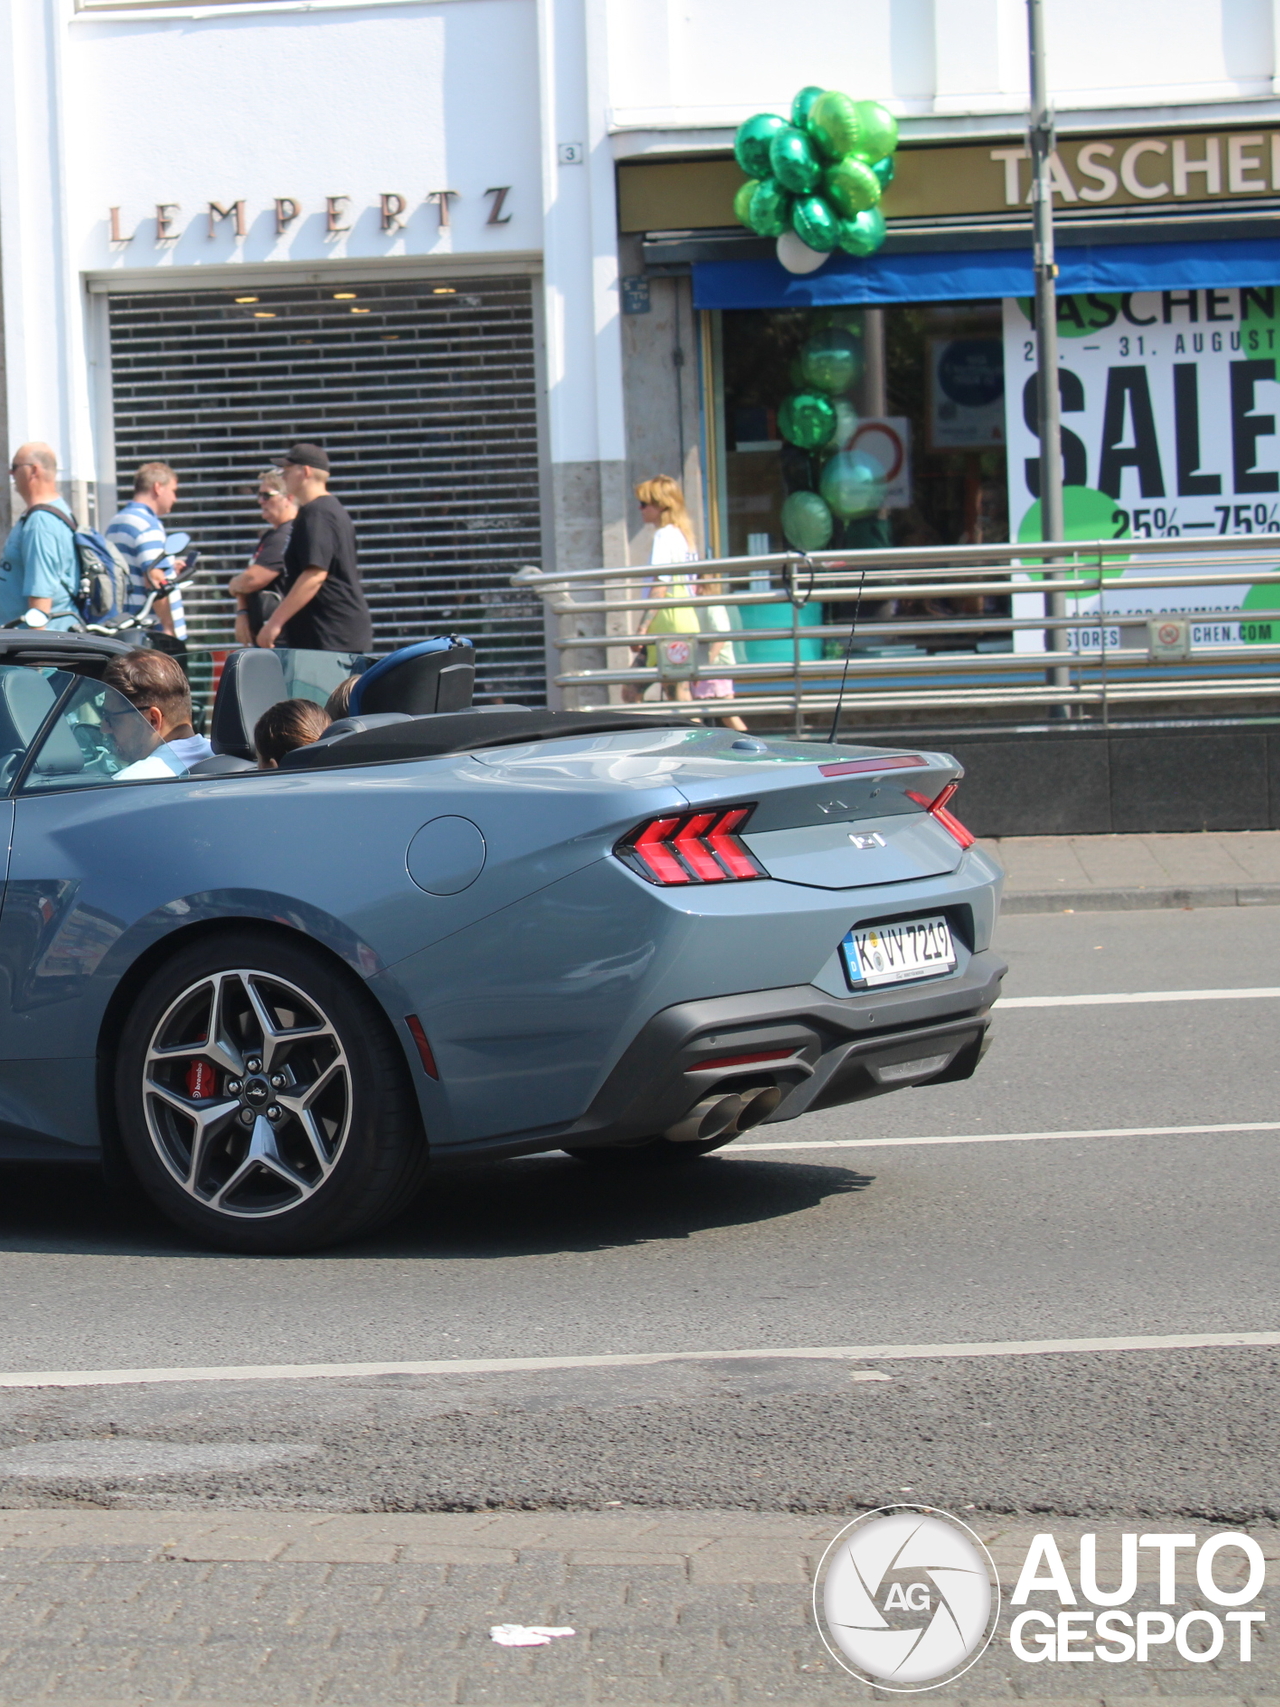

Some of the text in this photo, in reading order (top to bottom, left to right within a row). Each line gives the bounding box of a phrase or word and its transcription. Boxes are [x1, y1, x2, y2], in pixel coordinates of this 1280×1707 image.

[566, 147, 575, 161] 3
[990, 133, 1280, 205] TASCHE
[110, 186, 513, 243] LEMPERTZ
[1030, 287, 1275, 331] ASCHEN
[1024, 341, 1064, 361] 2.
[1120, 336, 1157, 356] 31.
[1175, 329, 1276, 354] AUGUST
[1023, 358, 1279, 500] SALE
[1193, 623, 1272, 643] CHEN.COM
[855, 933, 874, 972] K
[880, 927, 906, 966] VY
[906, 921, 948, 962] 7219
